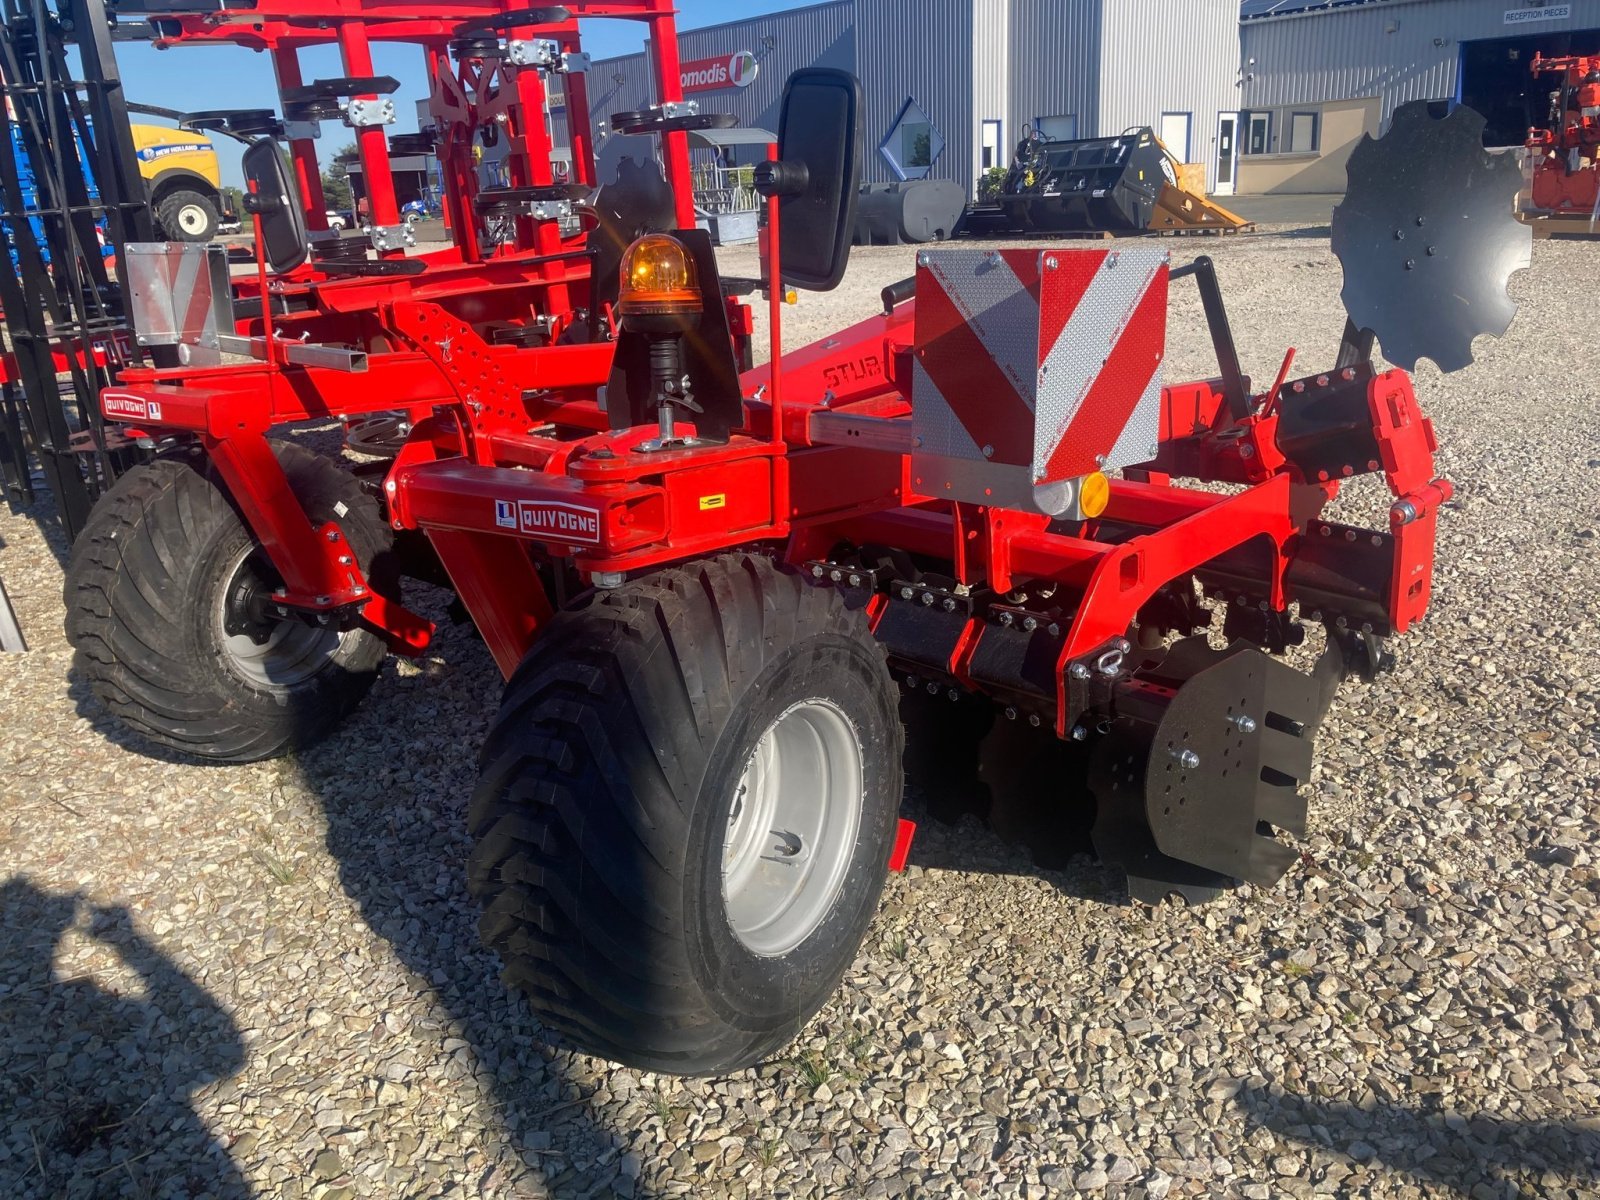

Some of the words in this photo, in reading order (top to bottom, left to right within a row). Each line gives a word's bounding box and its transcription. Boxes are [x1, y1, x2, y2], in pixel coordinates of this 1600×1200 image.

[1505, 11, 1543, 21] RECEPTION
[680, 63, 727, 88] omodis
[155, 148, 170, 157] NEW
[170, 145, 198, 153] HOLLAND
[106, 399, 145, 413] QUIVOGNE
[523, 510, 596, 532] QUIVOGNE
